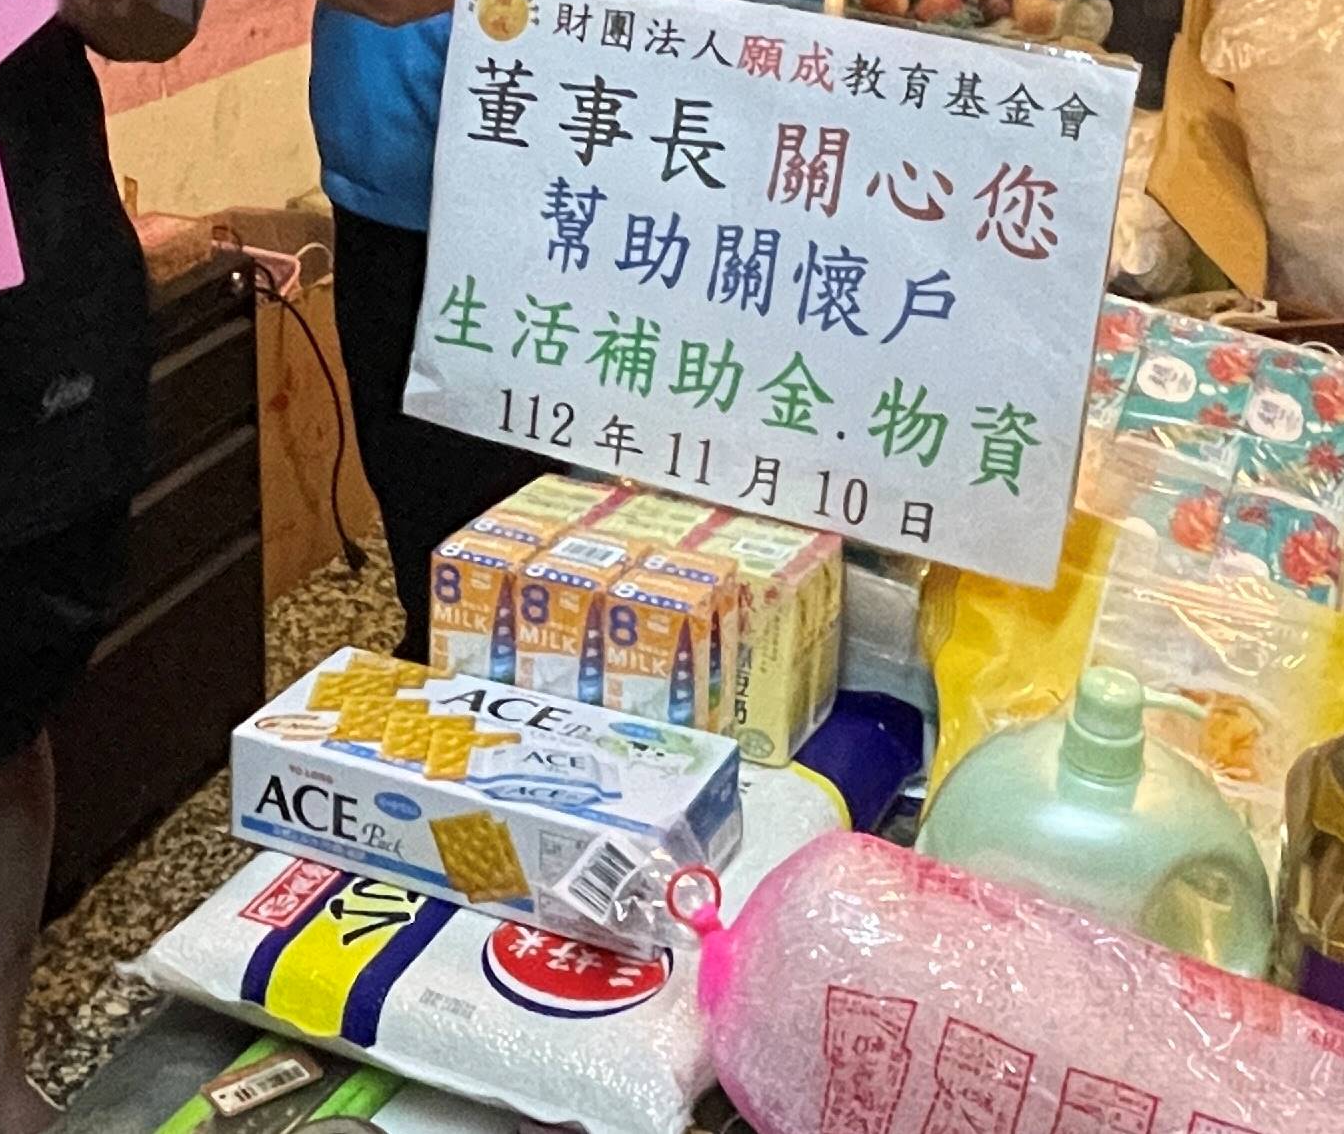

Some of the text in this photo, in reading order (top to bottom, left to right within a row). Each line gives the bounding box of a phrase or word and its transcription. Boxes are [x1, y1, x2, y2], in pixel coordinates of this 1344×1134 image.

[553, 2, 1099, 142] 財團法人願成教育基金會
[540, 177, 956, 344] 幫助關懷戶
[434, 563, 461, 603] 8
[433, 603, 488, 633] MILK
[521, 584, 549, 625] 8
[520, 625, 578, 654] MILK
[609, 605, 638, 646] 8
[608, 646, 669, 677] MILK
[438, 689, 572, 731] ACE
[524, 751, 586, 767] ACE
[254, 775, 358, 842] ACE
[362, 822, 404, 859] Pack
